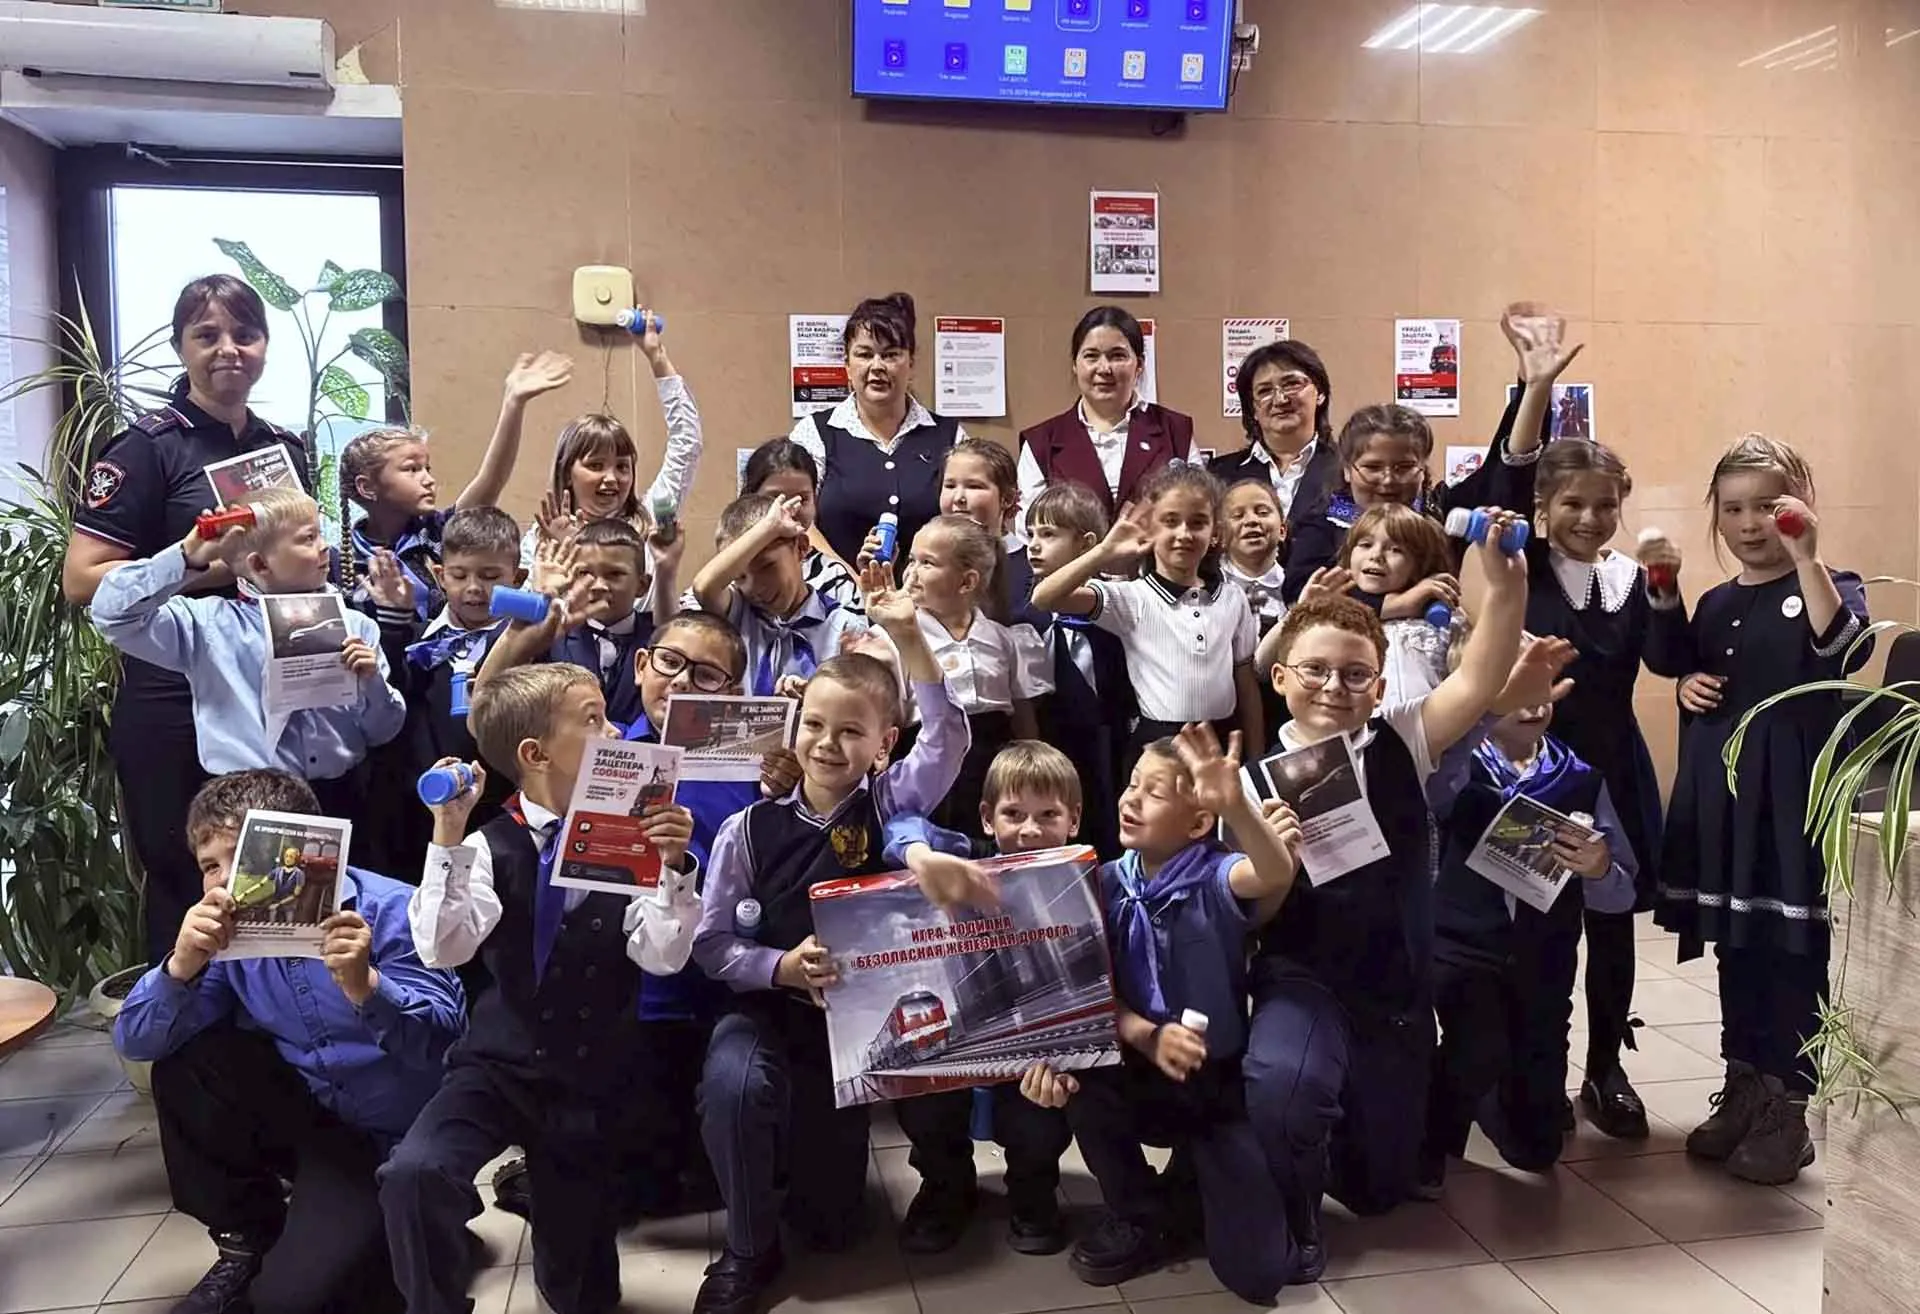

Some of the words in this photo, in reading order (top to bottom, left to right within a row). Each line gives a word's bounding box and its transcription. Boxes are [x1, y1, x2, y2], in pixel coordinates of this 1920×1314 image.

[597, 749, 636, 760] УВИДЕЛ
[594, 758, 644, 771] ЗАЦЕПЕРА
[945, 934, 1017, 956] ЖЕЛЕЗНАЯ
